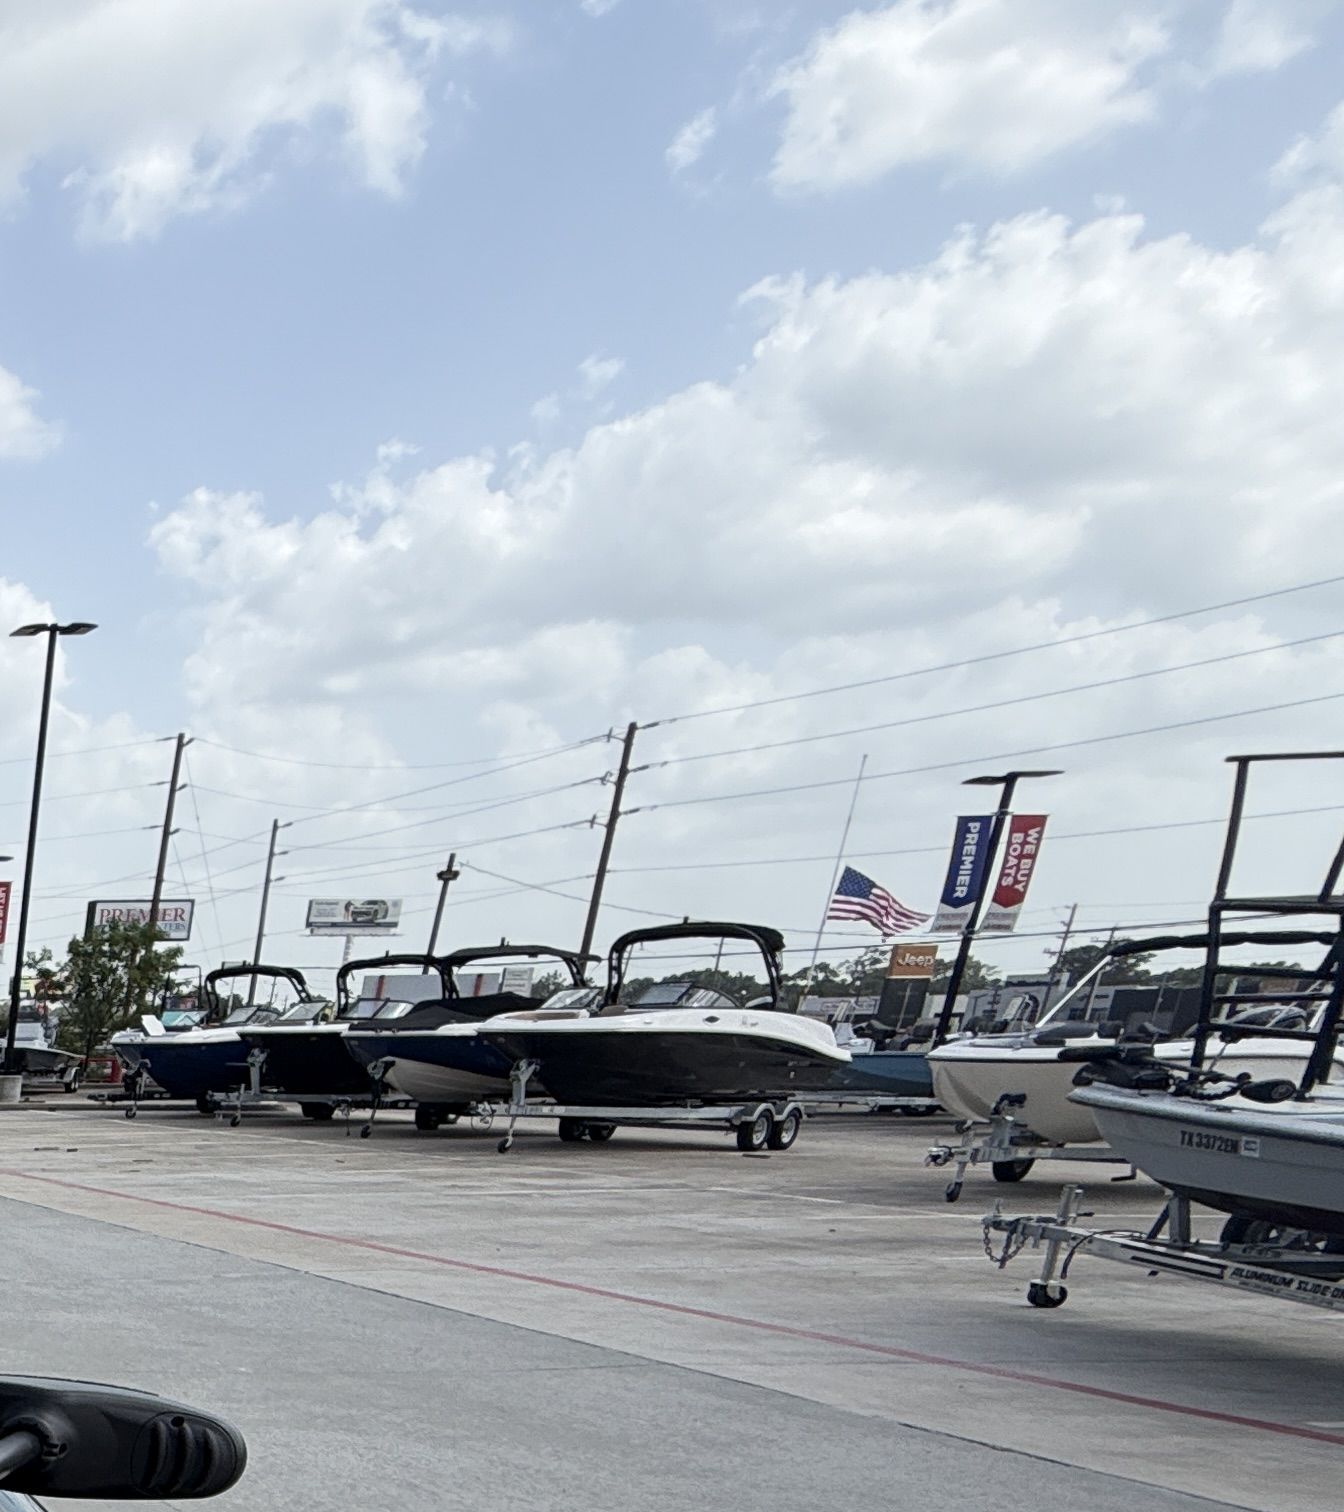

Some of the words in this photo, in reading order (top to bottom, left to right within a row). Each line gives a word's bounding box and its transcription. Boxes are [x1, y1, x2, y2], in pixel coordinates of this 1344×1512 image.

[1023, 827, 1041, 854] WE
[953, 822, 981, 898] PREMIER
[1001, 833, 1024, 887] BOATS
[1014, 859, 1033, 892] BUY
[897, 953, 934, 966] Jeep
[1230, 1267, 1294, 1288] ALUMINUM
